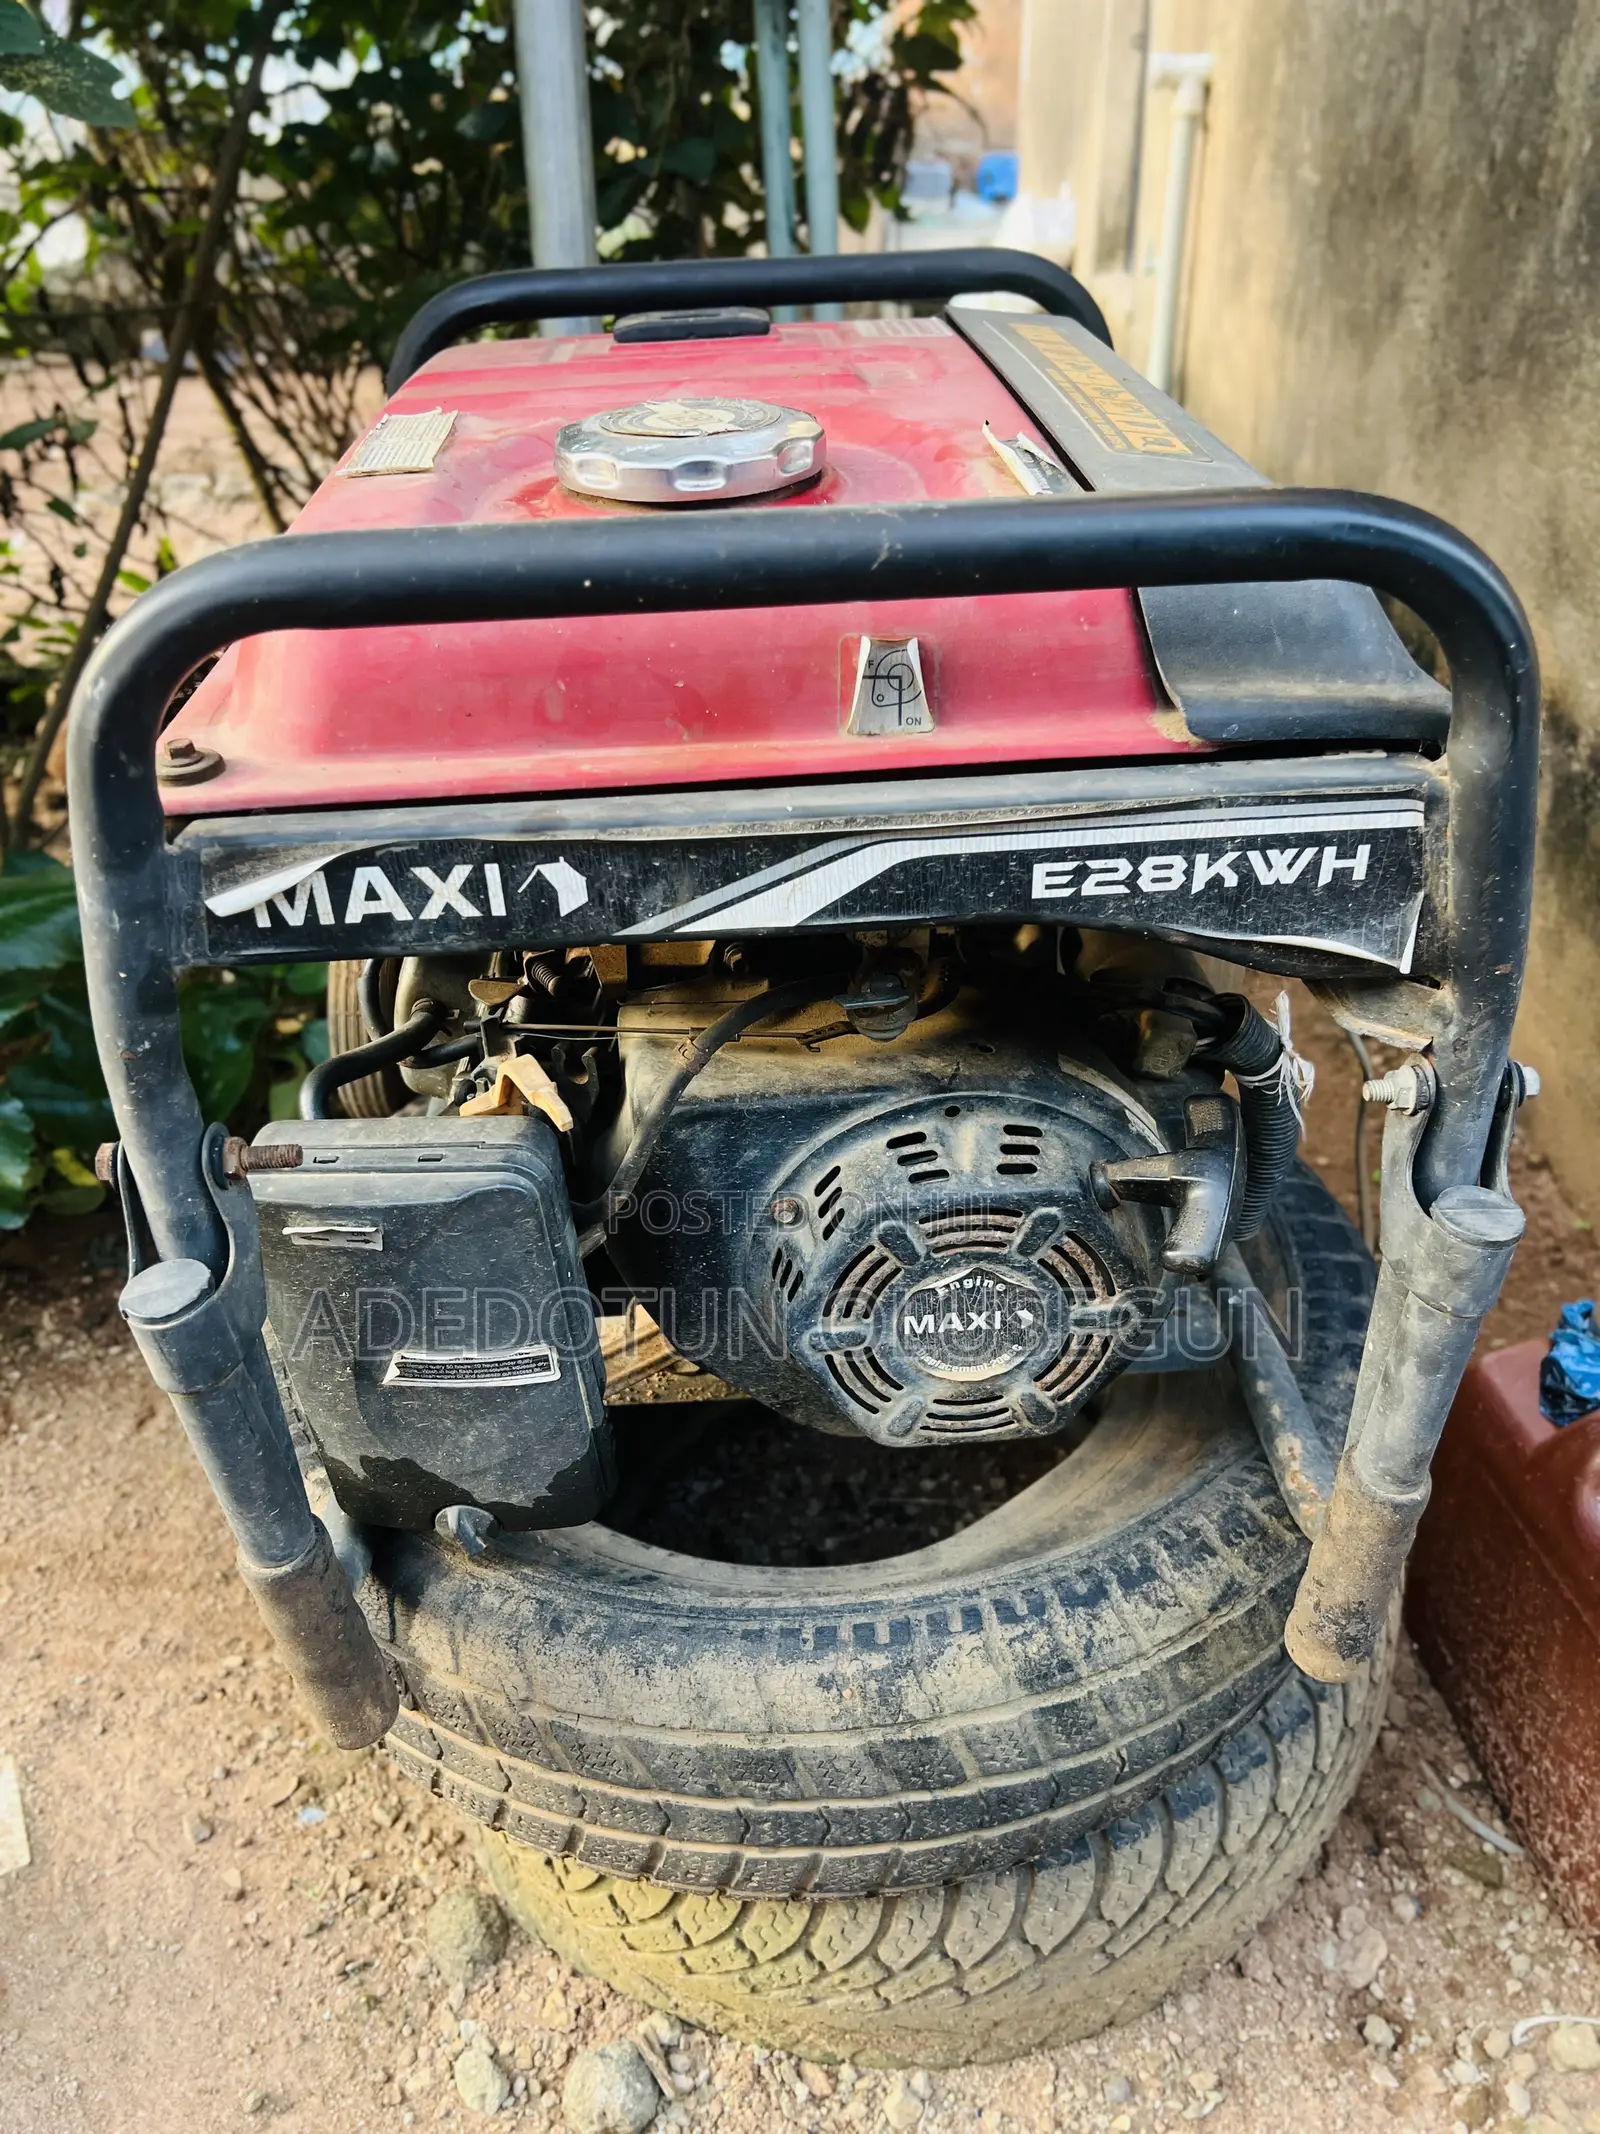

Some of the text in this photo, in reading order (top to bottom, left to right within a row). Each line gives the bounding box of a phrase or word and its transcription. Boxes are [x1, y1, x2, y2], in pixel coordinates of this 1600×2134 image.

[905, 717, 922, 726] ON
[1031, 844, 1372, 900] E28KWH
[253, 862, 508, 929] MAXI
[935, 1275, 1006, 1297] Engine
[903, 1310, 1002, 1335] MAXI
